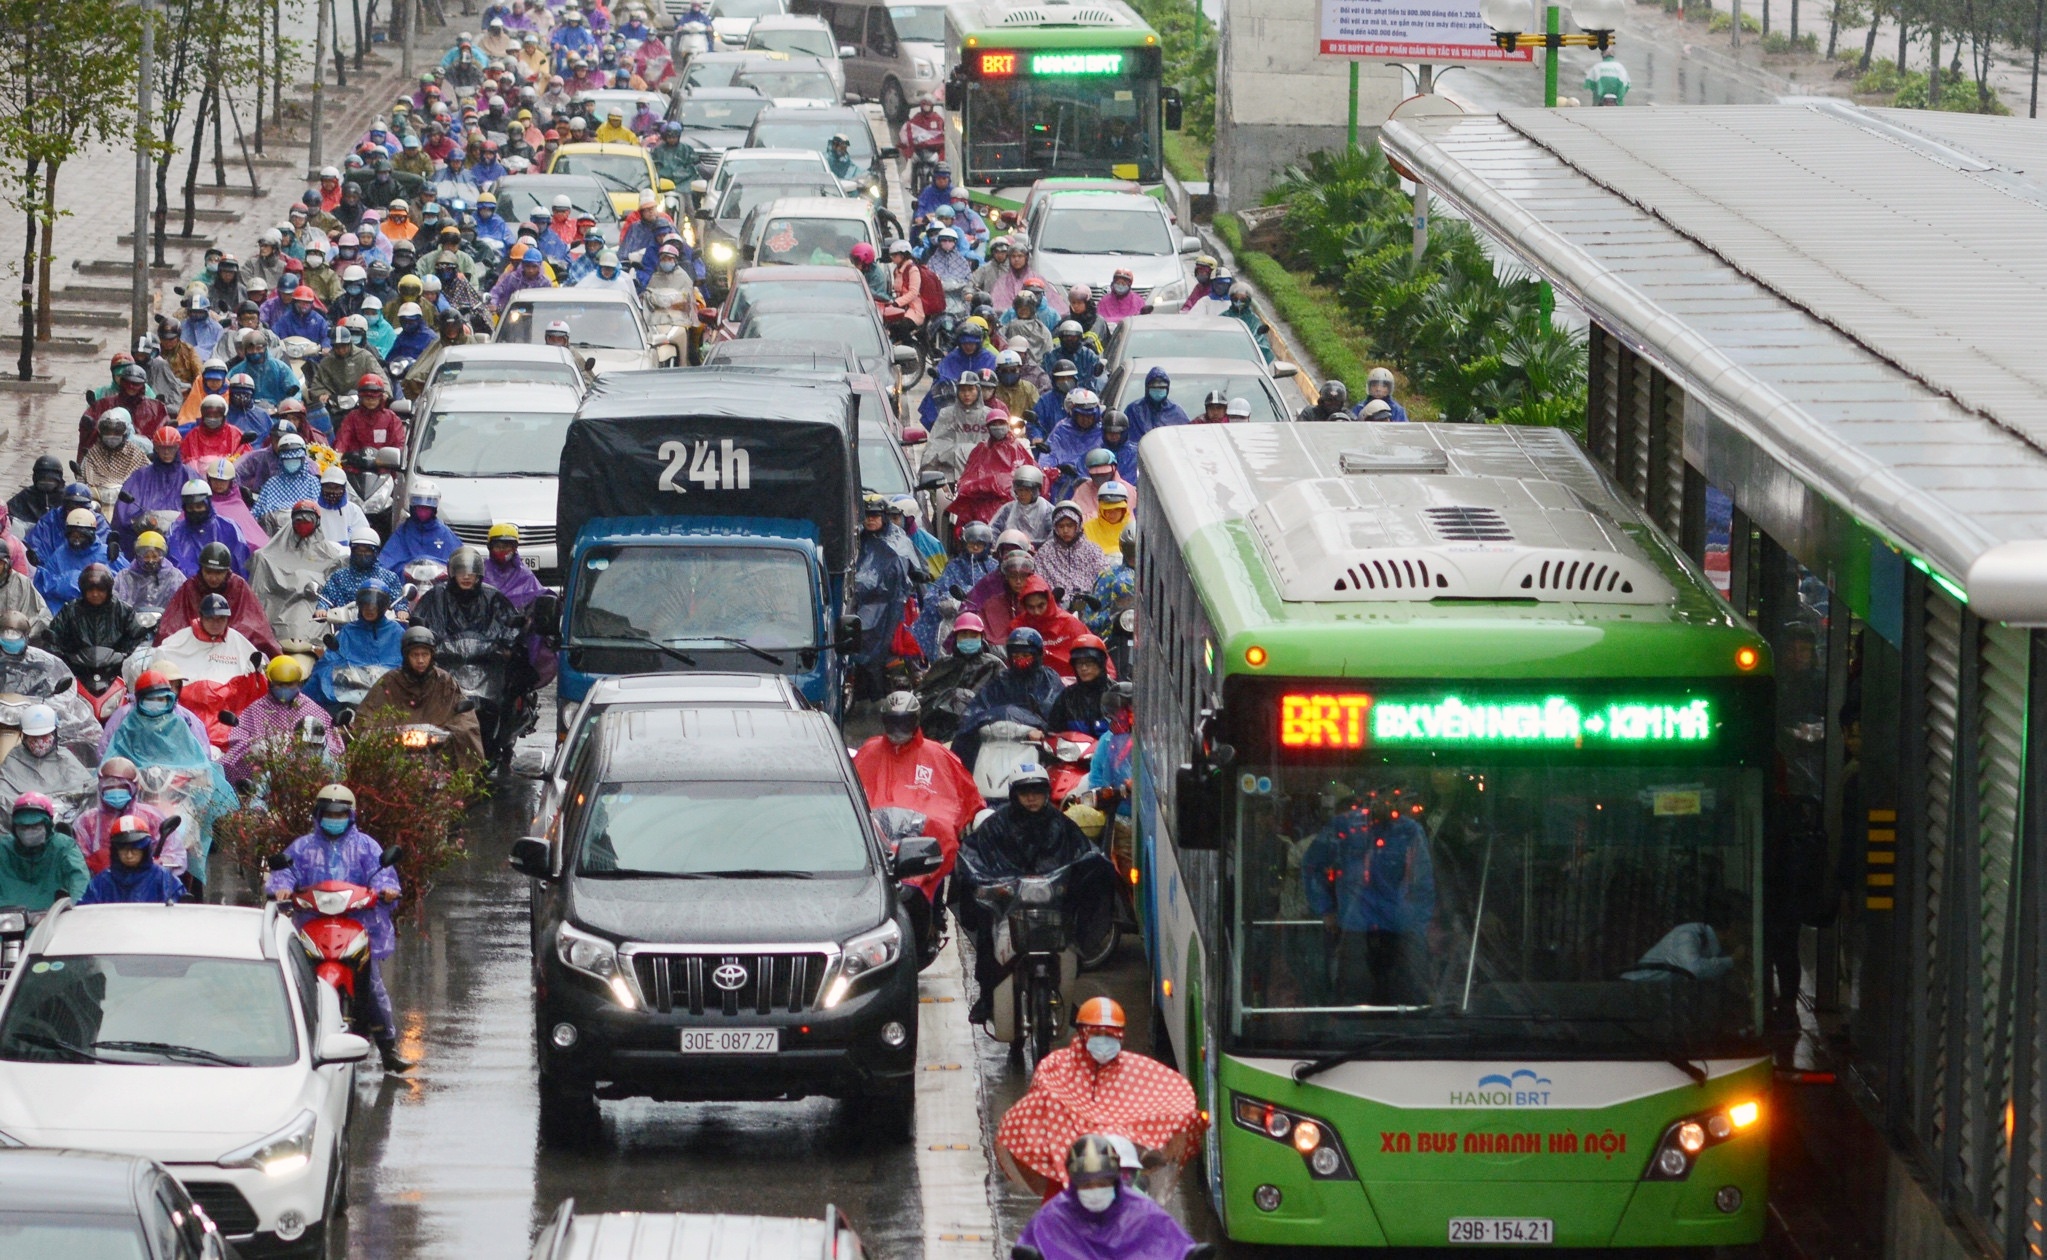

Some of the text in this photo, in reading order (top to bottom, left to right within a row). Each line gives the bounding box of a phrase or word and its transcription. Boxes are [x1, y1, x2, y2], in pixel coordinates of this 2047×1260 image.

[981, 55, 1015, 73] BRT
[658, 438, 751, 494] 24h
[1282, 695, 1369, 745] BRT
[1611, 706, 1661, 739] KIM
[684, 1032, 775, 1051] 30E-087.27
[1417, 1131, 1458, 1154] BUS
[1464, 1132, 1542, 1154] NHANH
[1548, 1127, 1578, 1154] HÀ
[1584, 1127, 1627, 1161] NỘI
[1451, 1221, 1549, 1241] 29B-154.21
